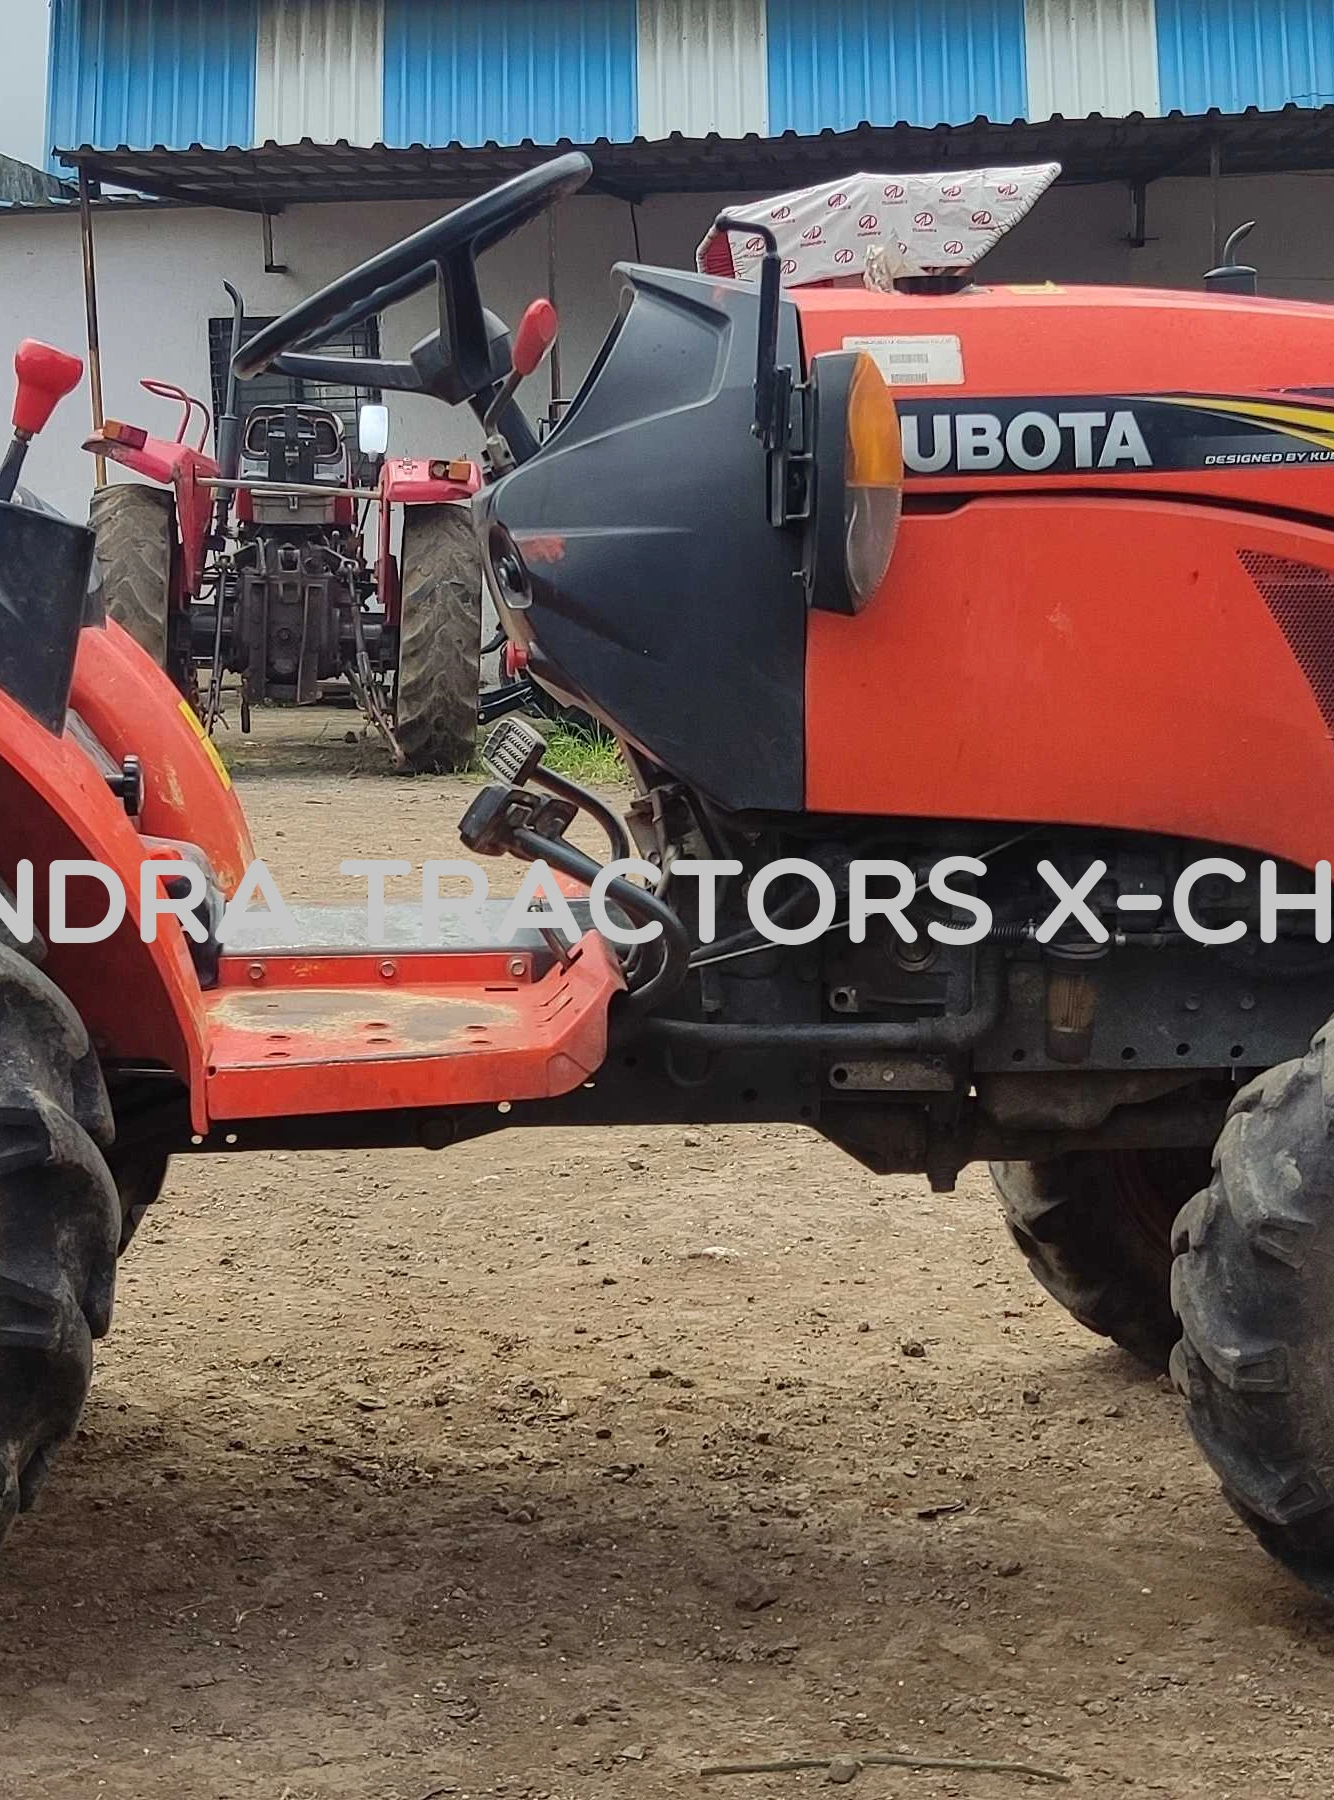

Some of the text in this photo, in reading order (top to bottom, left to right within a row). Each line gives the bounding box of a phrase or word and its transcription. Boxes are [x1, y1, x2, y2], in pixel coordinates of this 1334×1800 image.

[900, 411, 1153, 473] UBOTA
[1205, 453, 1284, 465] DESIGNED
[1285, 452, 1307, 462] BY
